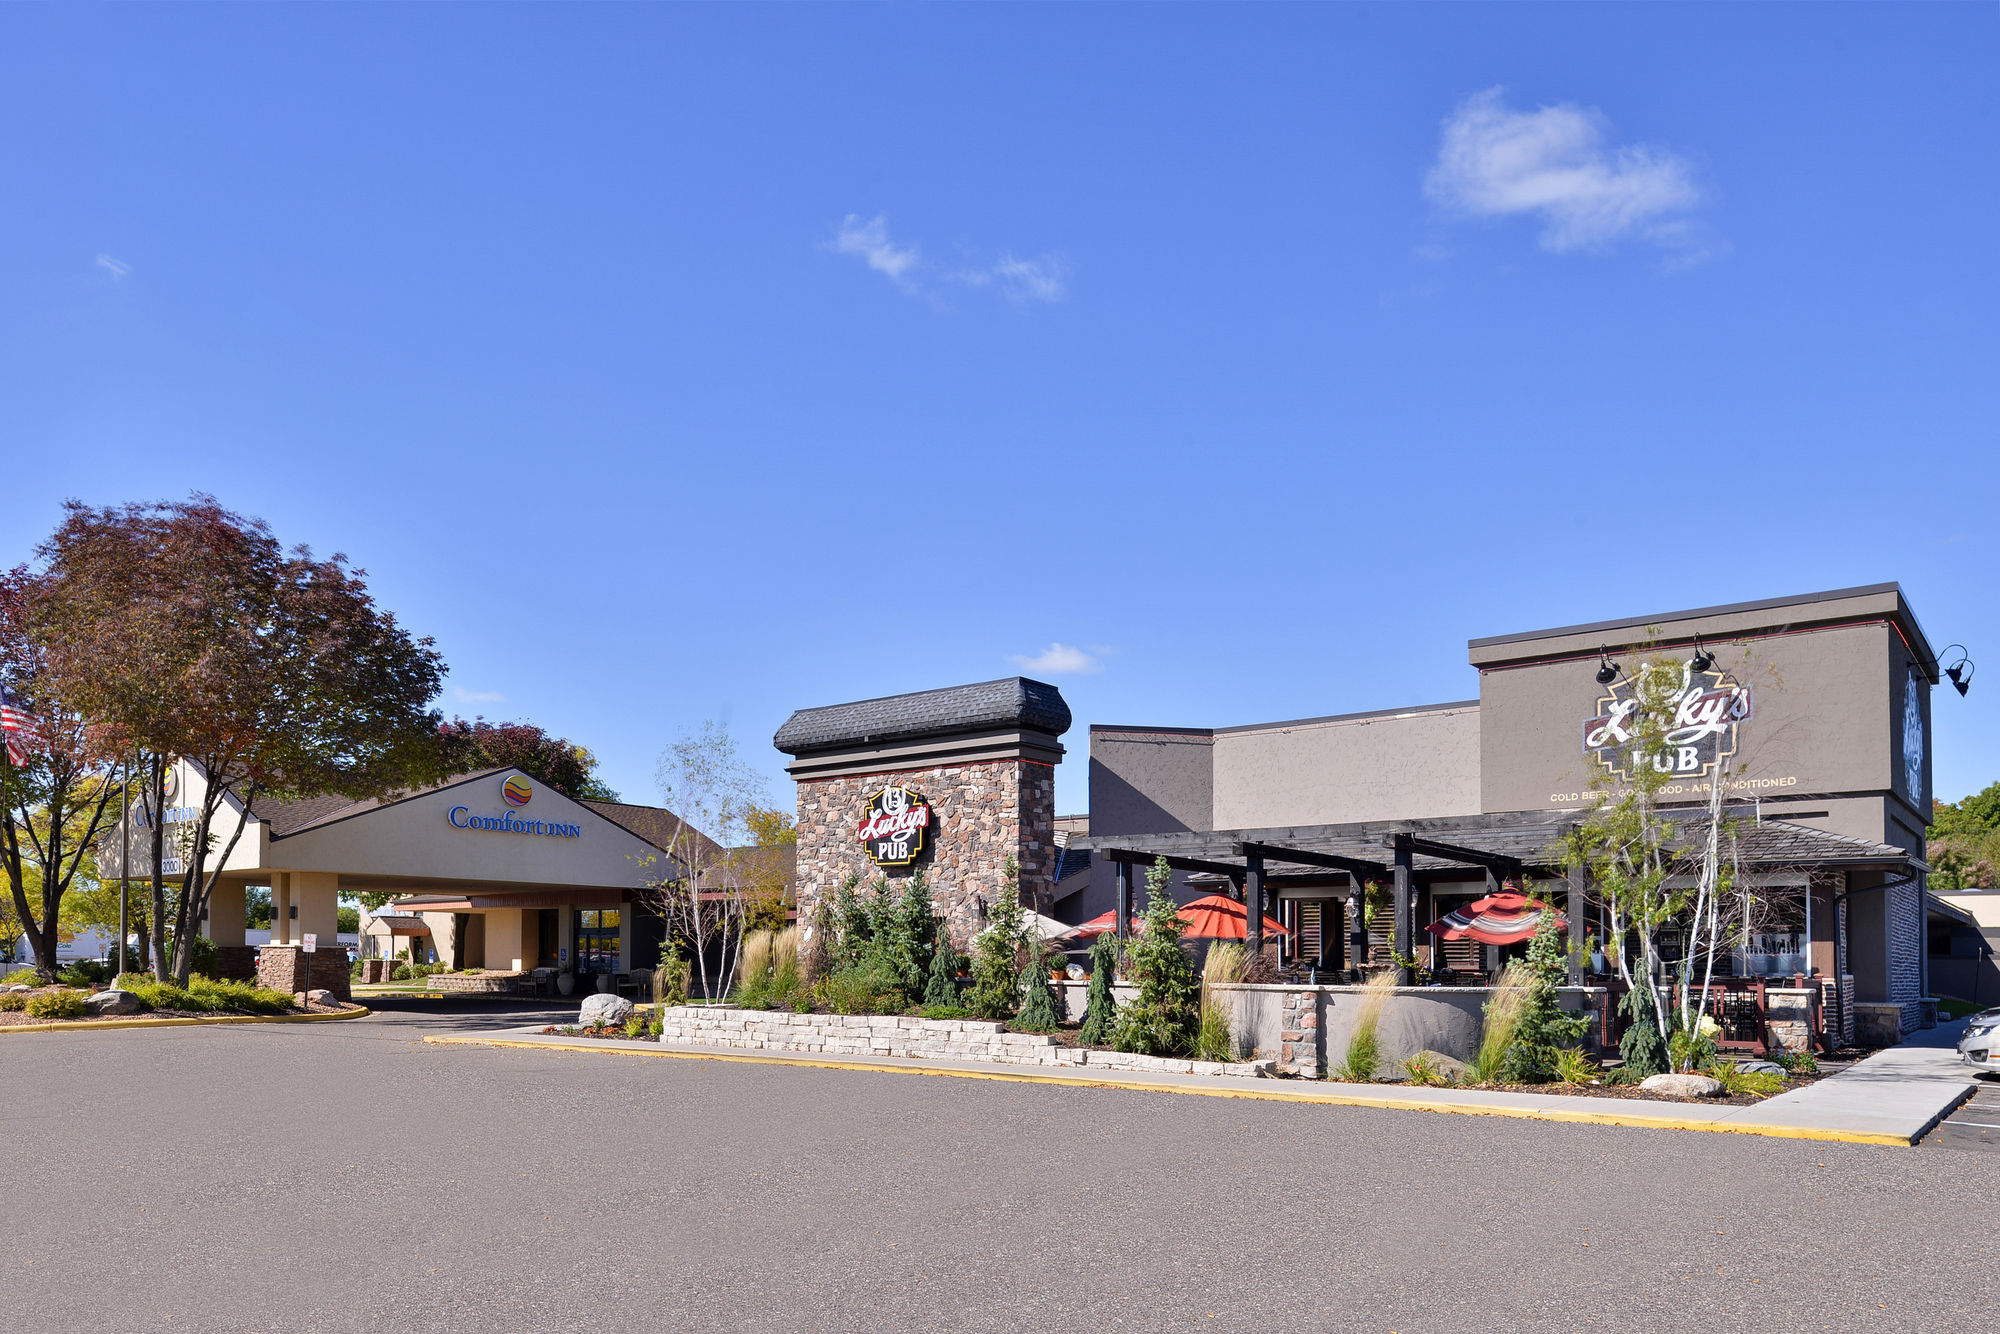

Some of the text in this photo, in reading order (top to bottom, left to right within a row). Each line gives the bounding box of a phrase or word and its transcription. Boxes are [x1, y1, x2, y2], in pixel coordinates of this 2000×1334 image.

[1550, 793, 1579, 802] COLD
[1582, 790, 1610, 800] BEER
[1655, 785, 1683, 795] OOD
[1692, 783, 1711, 793] AIR
[1717, 776, 1797, 791] NDITIONED
[178, 806, 196, 822] INN
[449, 806, 581, 838] Comfort INN
[859, 804, 927, 842] Lucky's
[878, 841, 908, 860] PUB
[162, 860, 178, 873] 3000
